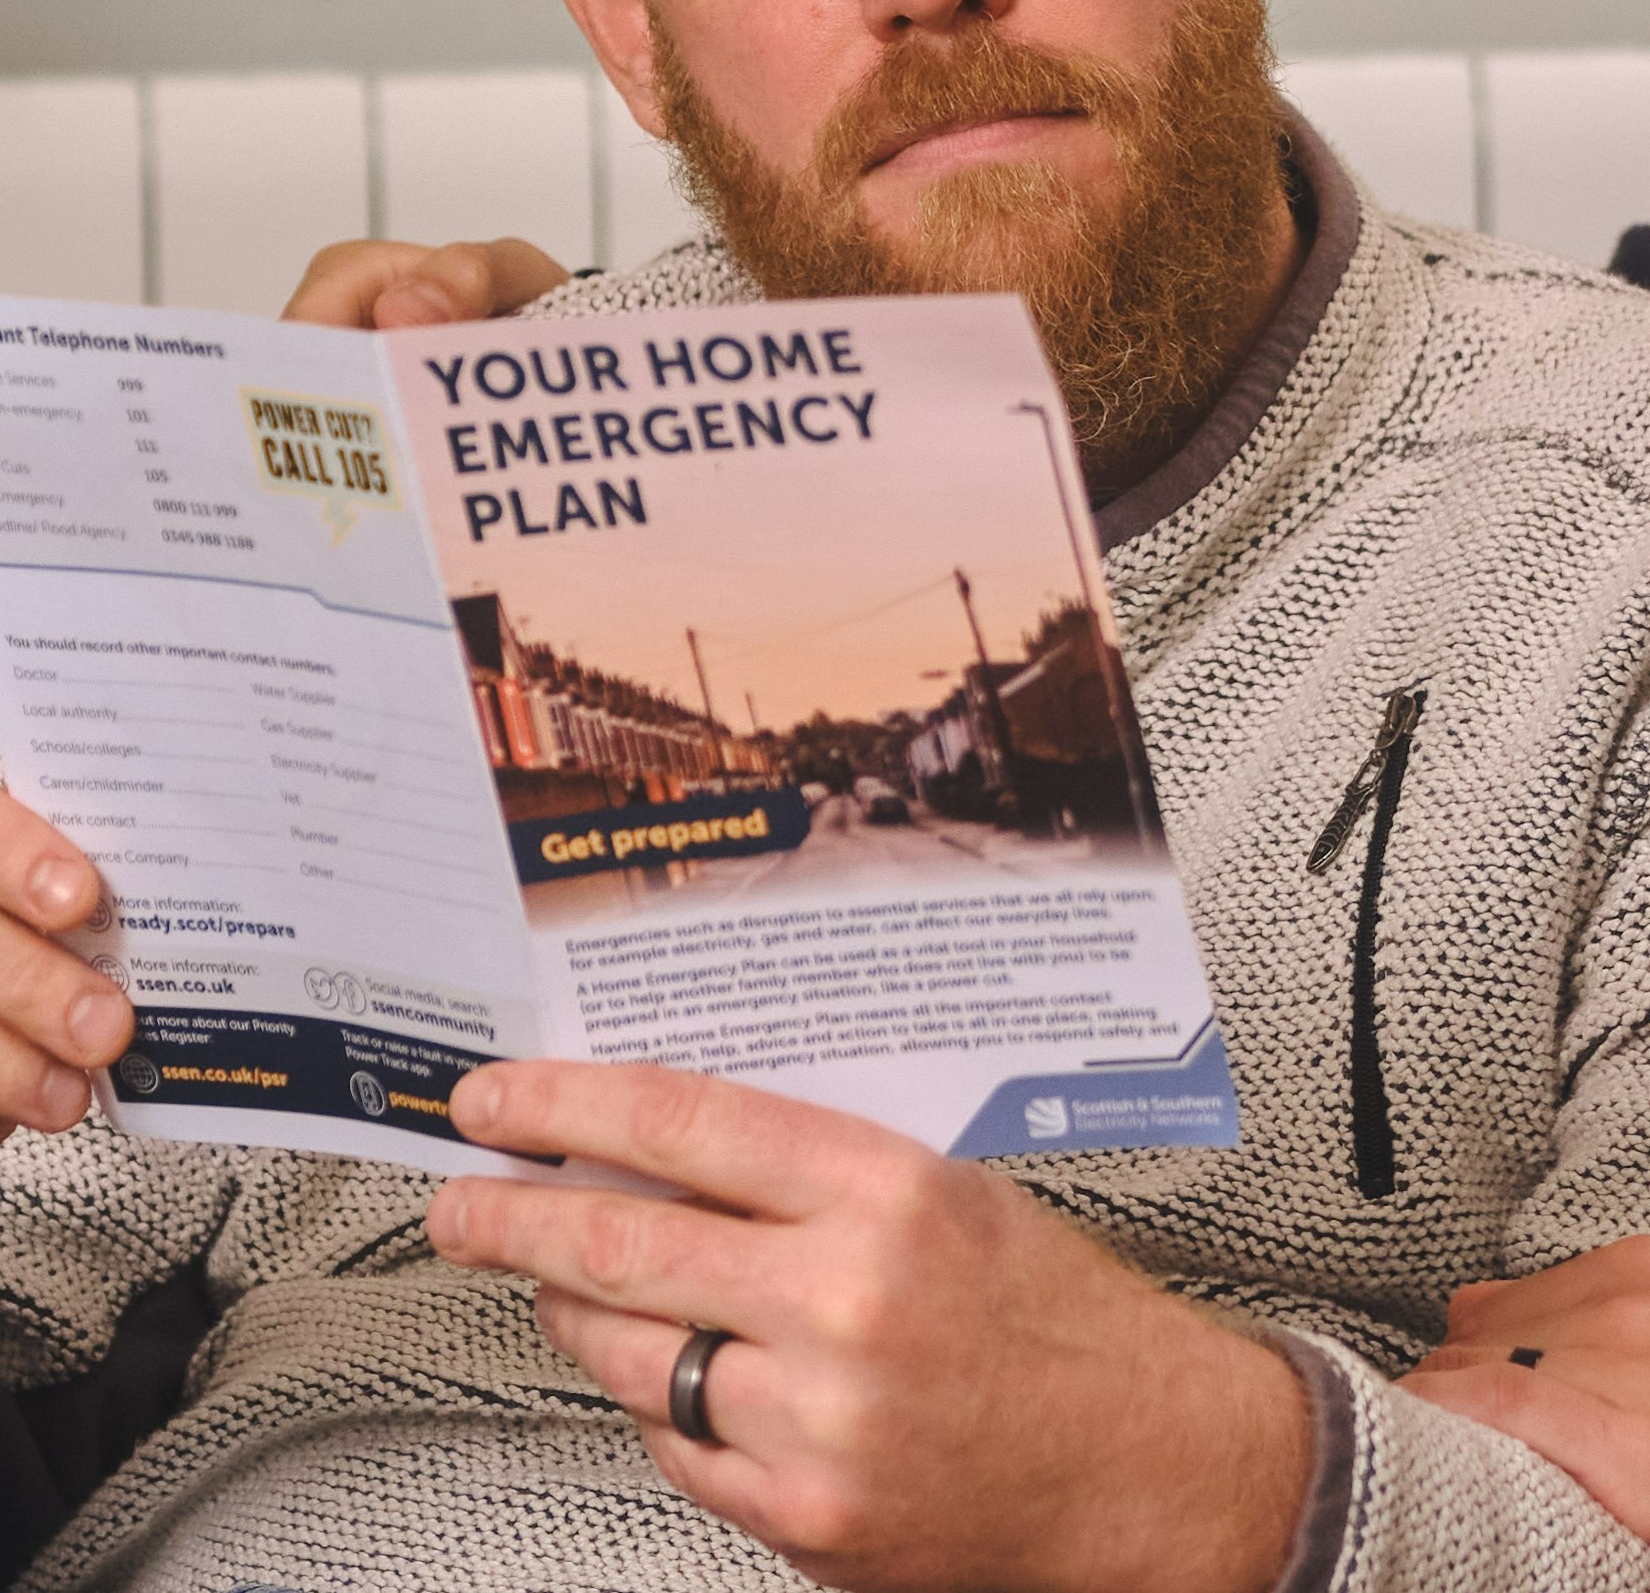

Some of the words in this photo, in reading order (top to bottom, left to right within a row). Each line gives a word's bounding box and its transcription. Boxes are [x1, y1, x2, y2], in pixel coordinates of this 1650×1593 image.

[30, 327, 130, 350] Telephone
[134, 335, 224, 356] Numbers
[423, 346, 628, 406] YOUR
[644, 329, 863, 389] HOME
[117, 378, 143, 391] 999
[126, 409, 150, 423] 101
[249, 398, 323, 437] POWER
[326, 406, 374, 436] CUT?
[446, 391, 877, 474] EMERGENCY
[135, 439, 158, 453] 111
[145, 469, 168, 483] 105
[261, 436, 335, 487] CALL
[340, 443, 389, 495] 105
[462, 477, 648, 543] PLAN
[5, 634, 31, 648] You
[32, 637, 78, 650] should
[79, 641, 125, 653] record
[126, 642, 162, 654] other
[164, 646, 228, 660] important
[229, 652, 277, 666] contact
[12, 665, 58, 681] Doctor
[251, 683, 285, 698] Water
[287, 687, 336, 705] Supplier
[22, 704, 58, 717] Local
[60, 706, 118, 720] authority
[260, 717, 285, 733] Gas
[285, 722, 334, 740] Supplier
[30, 740, 141, 756] Schools/colleges
[270, 754, 328, 776] Electricity
[329, 764, 376, 782] Supplier
[39, 776, 164, 791] Carers/childminder
[280, 791, 301, 805] Vet
[49, 813, 83, 826] Work
[86, 815, 136, 827] contact
[289, 826, 338, 845] Plumber
[540, 831, 608, 865] Get
[611, 808, 770, 859] prepared
[124, 850, 189, 866] Company
[299, 862, 334, 879] Other
[112, 896, 150, 913] More
[118, 917, 295, 937] ready.scot/prepare
[565, 930, 670, 952] Emergencies
[738, 912, 821, 928] disruption
[847, 903, 918, 917] essential
[922, 898, 987, 911] services
[597, 947, 667, 965] example
[914, 916, 960, 929] affect
[996, 910, 1069, 923] everyday
[130, 958, 168, 971] More
[591, 978, 641, 992] Home
[645, 966, 736, 984] Emergency
[1050, 931, 1135, 945] household
[136, 979, 234, 993] ssen.co.uk
[366, 977, 402, 997] Social
[670, 983, 733, 999] another
[738, 976, 787, 990] family
[792, 969, 858, 982] member
[584, 1010, 659, 1031] prepared
[706, 994, 797, 1012] emergency
[927, 976, 978, 990] power
[156, 1016, 190, 1027] more
[191, 1017, 227, 1028] about
[229, 1020, 249, 1030] our
[252, 1019, 295, 1035] Priority
[371, 1001, 494, 1039] ssencommunity
[590, 1039, 648, 1054] Having
[665, 1030, 715, 1043] Home
[719, 1018, 810, 1036] Emergency
[854, 1007, 907, 1020] means
[965, 997, 1046, 1011] important
[1050, 992, 1112, 1005] contact
[745, 1037, 798, 1051] advice
[836, 1026, 888, 1040] action
[1097, 1008, 1157, 1020] making
[724, 1053, 815, 1071] emergency
[899, 1037, 969, 1051] allowing
[1028, 1027, 1095, 1042] respond
[1098, 1025, 1144, 1037] safely
[161, 1067, 287, 1085] ssen.co.uk/psr
